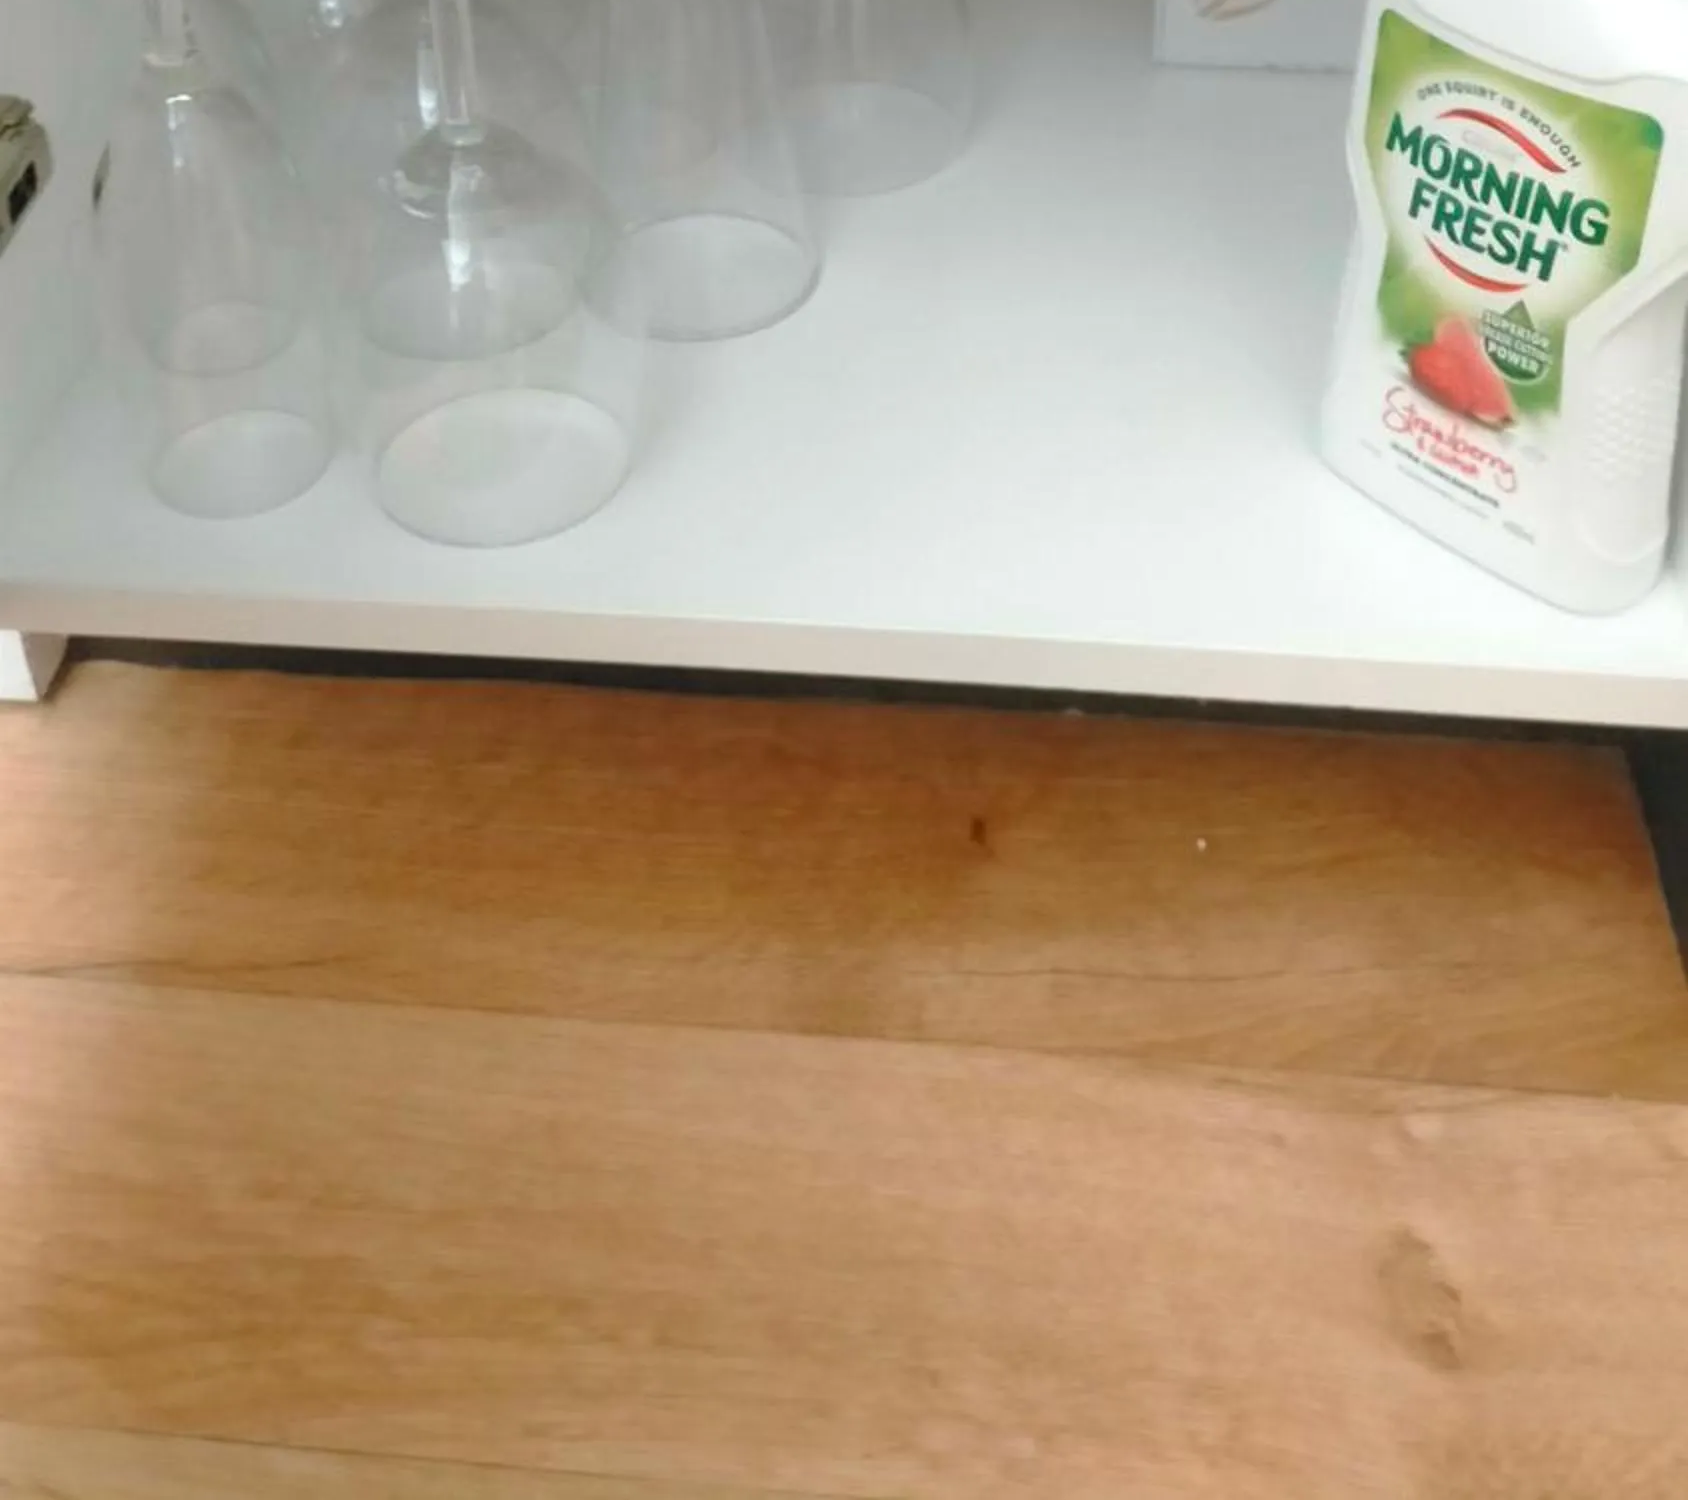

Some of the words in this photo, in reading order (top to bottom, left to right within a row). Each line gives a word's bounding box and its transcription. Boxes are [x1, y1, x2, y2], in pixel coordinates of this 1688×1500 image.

[1384, 110, 1611, 247] MORNING
[1519, 106, 1581, 169] ENOUGH
[1408, 177, 1560, 283] FRESH
